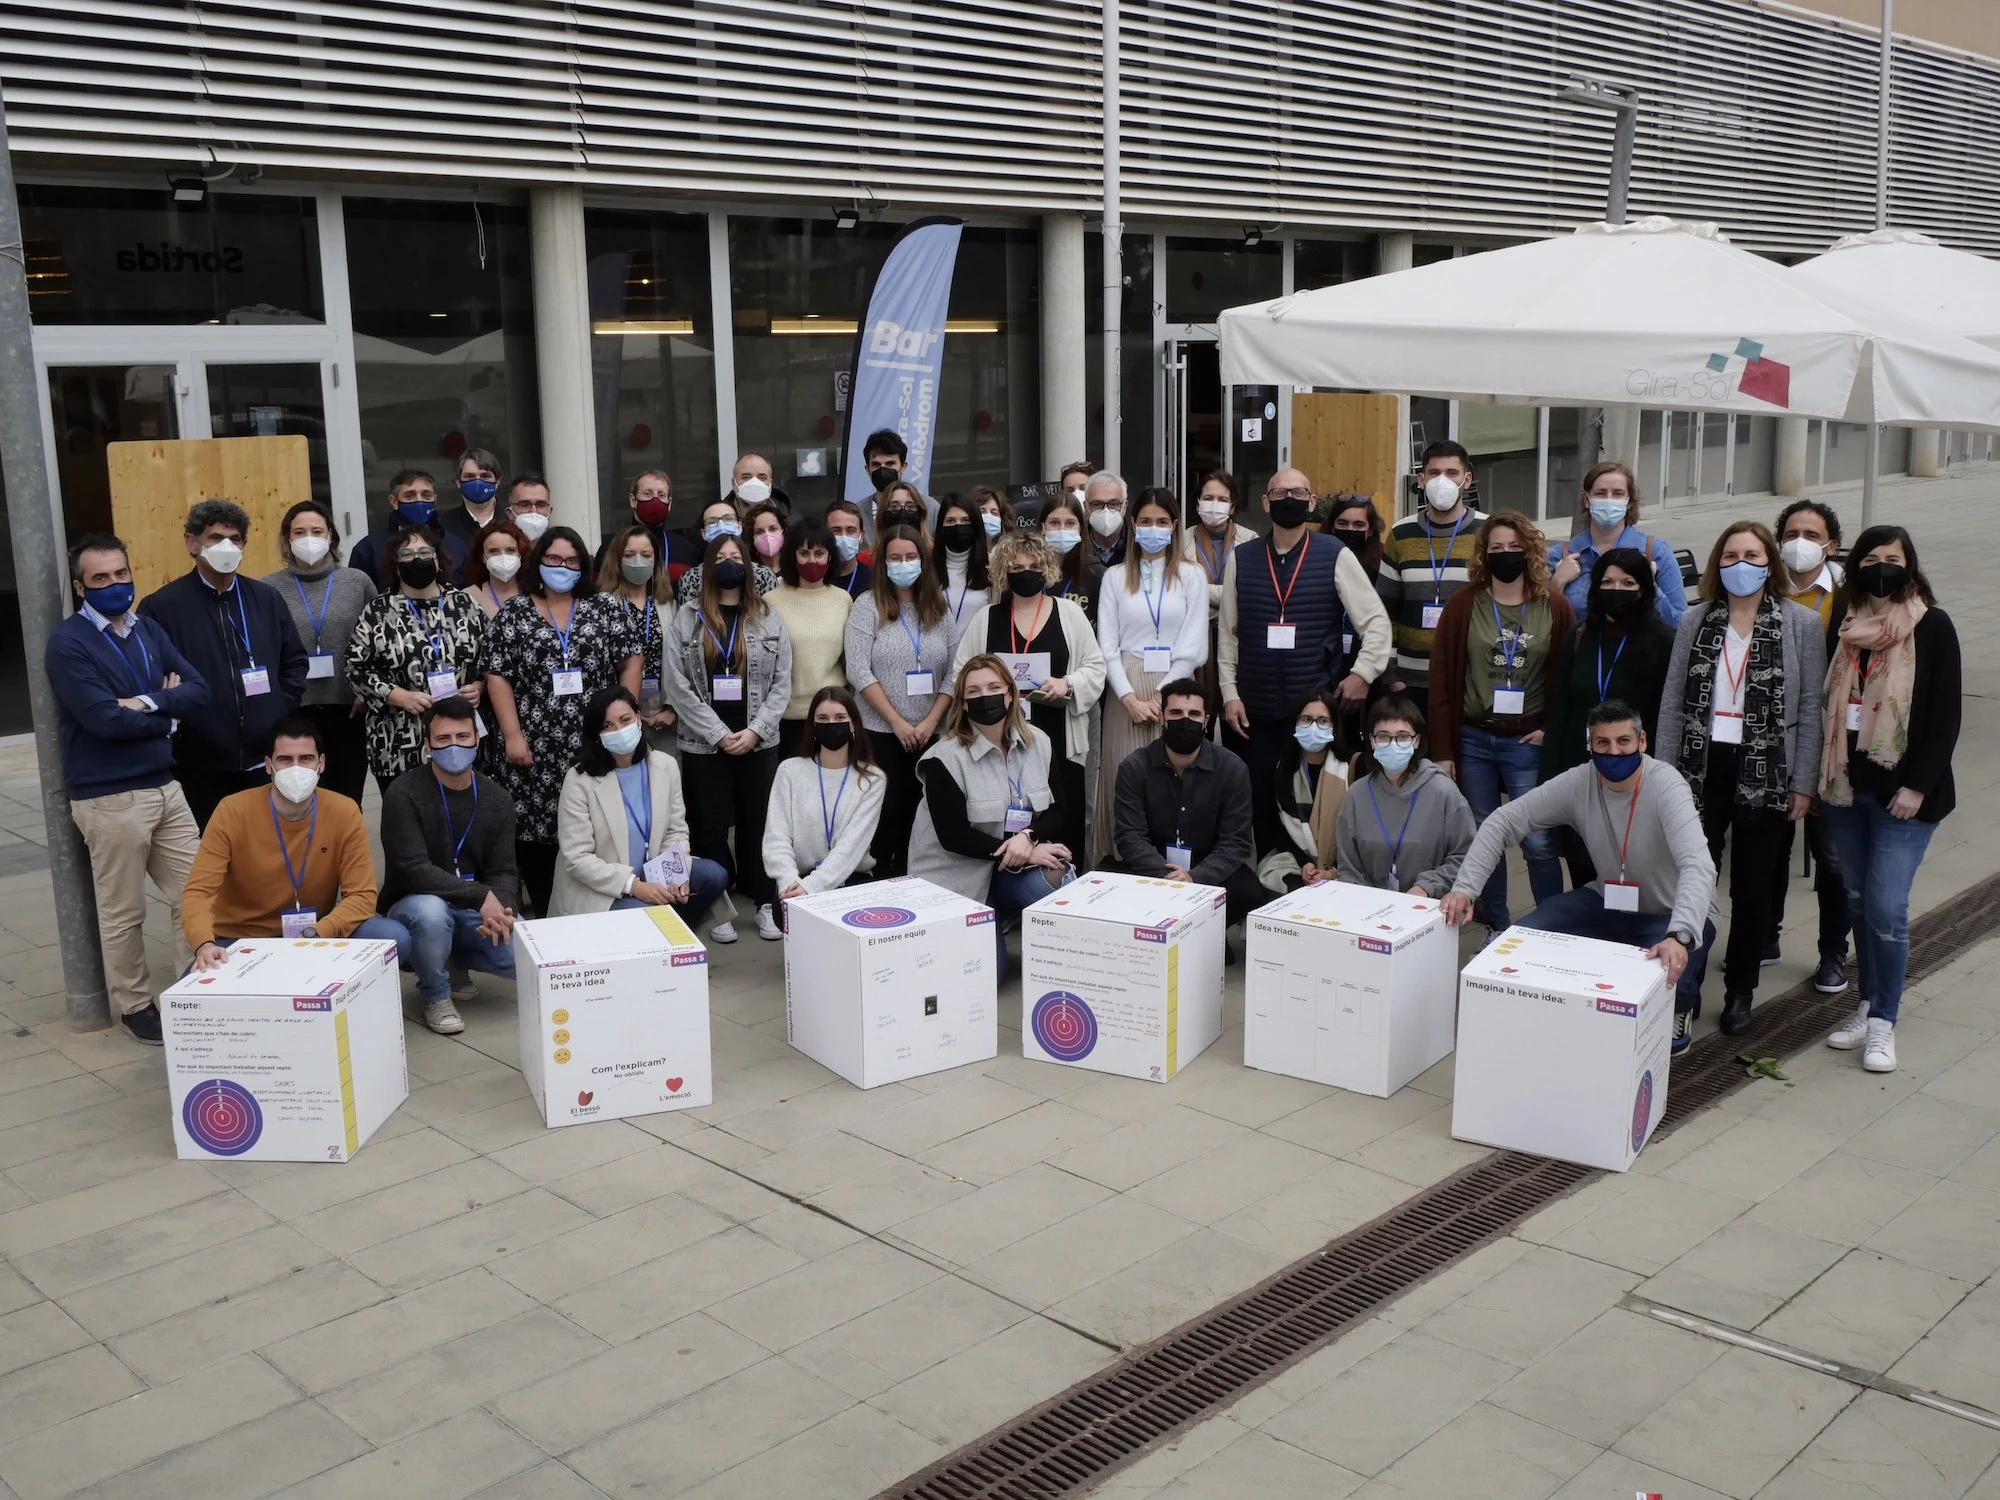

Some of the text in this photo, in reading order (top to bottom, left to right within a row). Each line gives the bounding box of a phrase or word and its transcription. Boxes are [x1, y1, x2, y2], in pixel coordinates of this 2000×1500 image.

[869, 320, 938, 357] Bar
[1021, 485, 1039, 497] BAR
[968, 914, 987, 925] Passa
[1031, 916, 1057, 927] Repte:
[1255, 922, 1300, 937] Idea triada:
[868, 927, 926, 946] El nostre equip
[1137, 931, 1157, 940] Passa
[1361, 940, 1382, 951] Passa
[673, 954, 705, 965] Passa 5
[550, 971, 573, 981] Posa
[583, 968, 611, 978] prova
[551, 977, 605, 991] la teva idea
[1466, 979, 1566, 1005] Imagina la teva idea:
[170, 1001, 202, 1011] Repte:
[296, 1001, 321, 1009] Passa
[1599, 1001, 1635, 1015] Passa 4
[591, 1057, 666, 1075] Com l'explicam?
[659, 1091, 692, 1102] L'emoció
[579, 1104, 601, 1113] bessó
